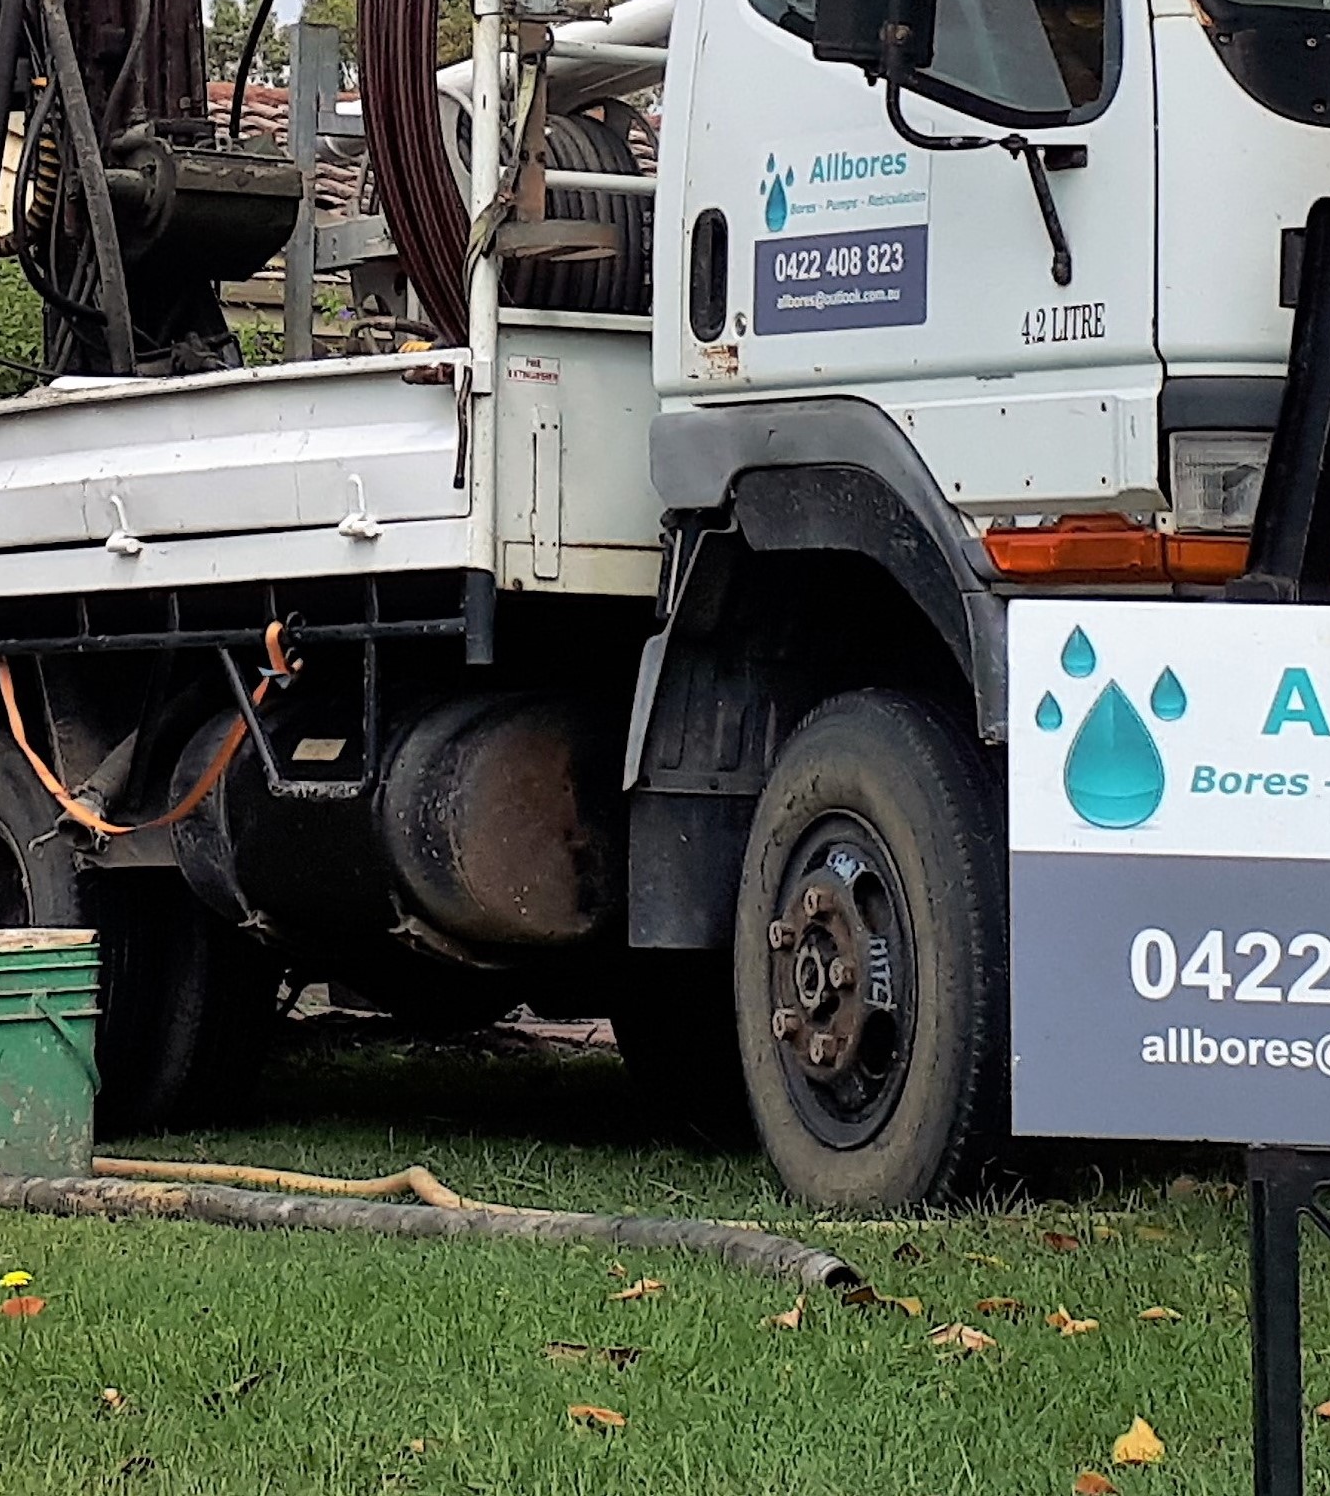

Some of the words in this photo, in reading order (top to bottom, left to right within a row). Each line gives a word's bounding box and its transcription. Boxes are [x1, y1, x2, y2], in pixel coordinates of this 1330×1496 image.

[809, 152, 908, 184] Allbores
[775, 251, 821, 283] 0422
[826, 247, 862, 277] 408
[867, 243, 904, 274] 823
[1051, 302, 1106, 342] LITRE
[1190, 764, 1309, 796] Bores
